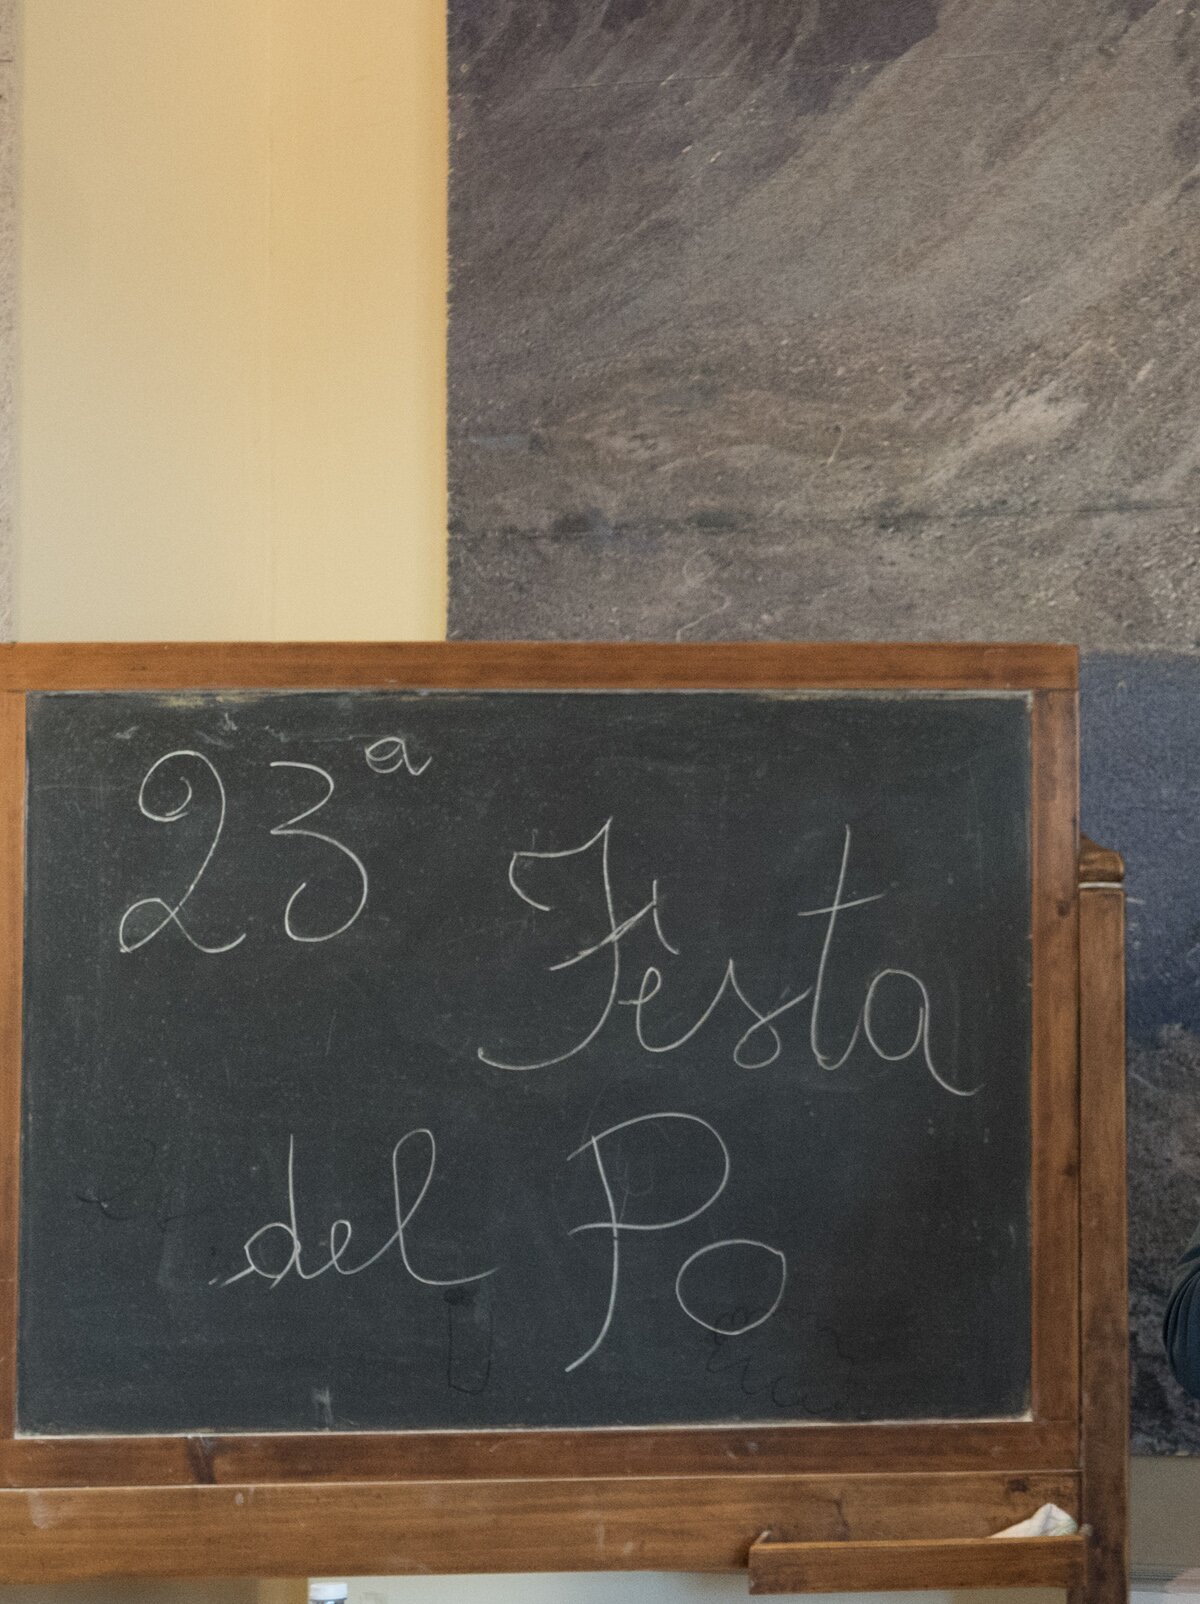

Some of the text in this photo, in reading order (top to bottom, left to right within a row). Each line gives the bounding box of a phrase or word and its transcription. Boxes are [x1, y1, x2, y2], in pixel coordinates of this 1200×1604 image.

[477, 816, 986, 1096] Festa
[209, 1112, 787, 1372] del Po
